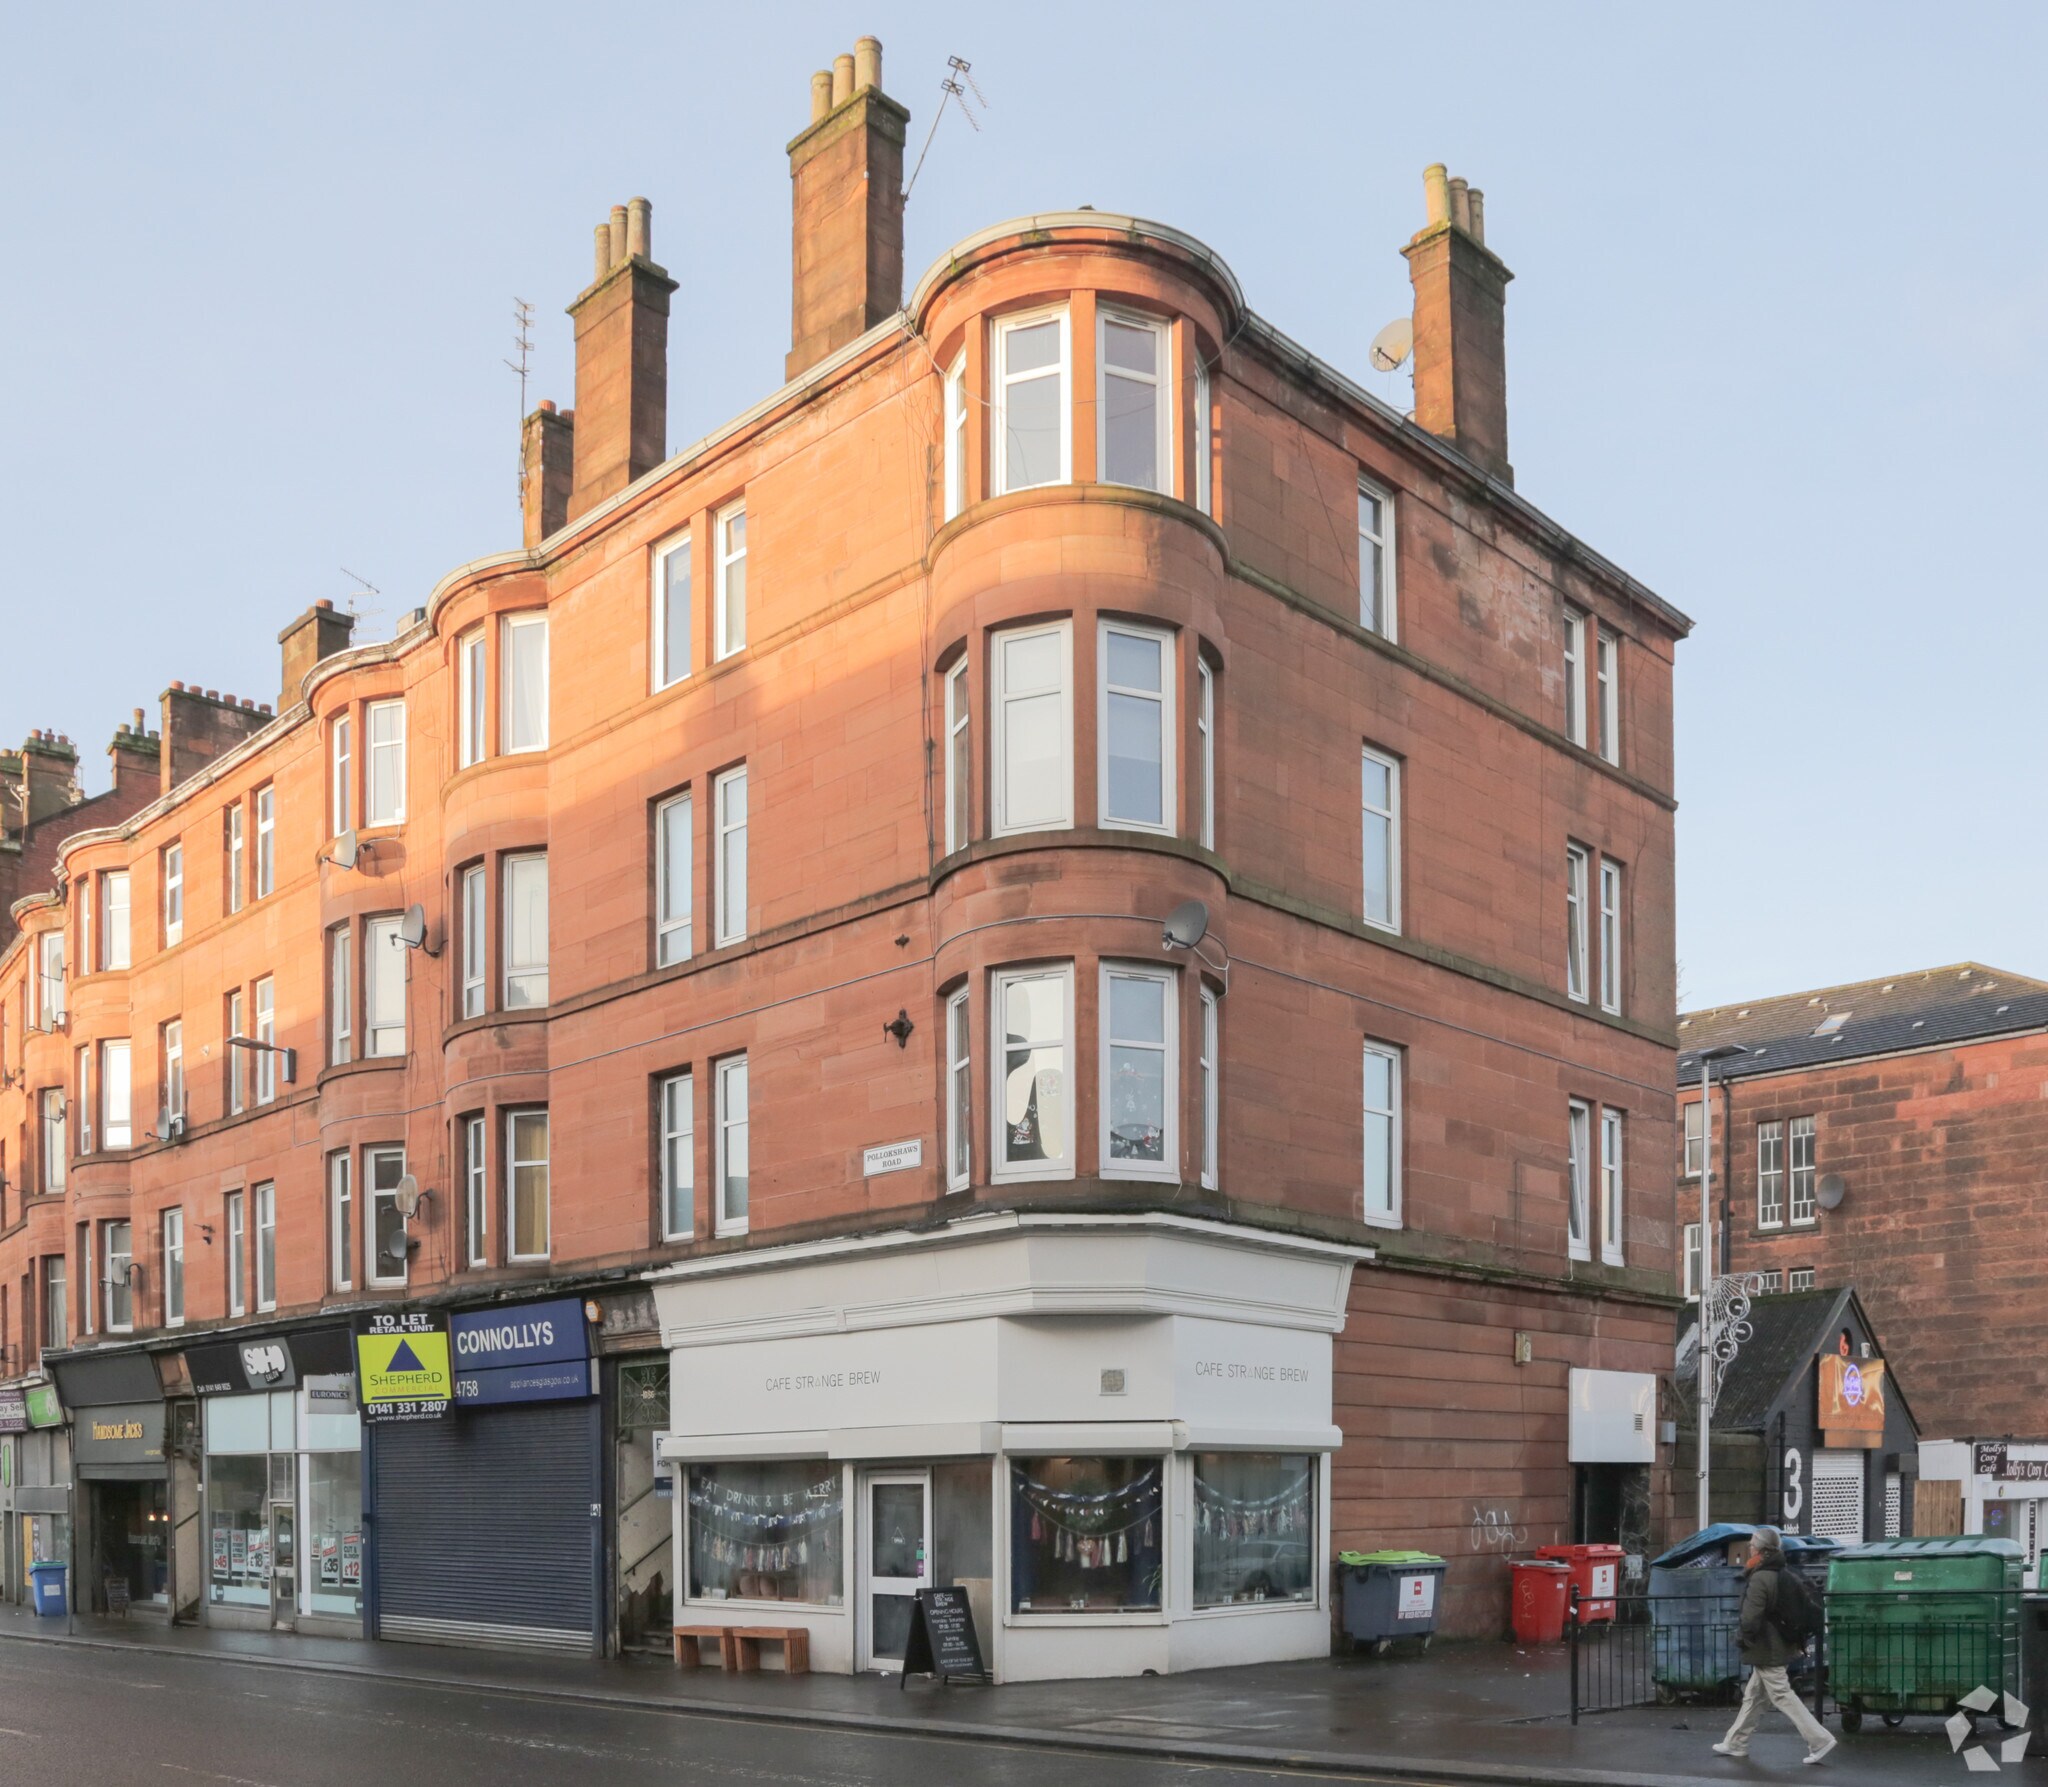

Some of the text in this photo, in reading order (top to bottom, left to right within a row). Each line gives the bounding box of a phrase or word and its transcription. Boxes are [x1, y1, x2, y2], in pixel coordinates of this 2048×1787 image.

[867, 1145, 918, 1161] POLLOKSHAWS
[882, 1158, 902, 1168] ROAD
[373, 1313, 428, 1327] TO LET
[369, 1324, 434, 1334] RETAIL UNIT
[457, 1321, 554, 1354] CONNOLLYS
[243, 1345, 286, 1375] SOHO
[265, 1370, 280, 1382] SALON
[369, 1372, 443, 1386] SHEPHERD
[1195, 1361, 1223, 1377] CAFE
[1280, 1367, 1309, 1382] BREW
[765, 1377, 791, 1391] CAFE
[849, 1370, 880, 1385] BREW
[375, 1385, 439, 1394] COMMERCIAL
[454, 1380, 479, 1397] 4758
[368, 1401, 447, 1414] 0141 331 2807
[376, 1412, 442, 1421] www.shepherd.co.uk
[1980, 1443, 2007, 1454] Molly's
[1980, 1454, 1997, 1463] Cosy
[2027, 1462, 2042, 1481] Cosy
[1784, 1448, 1802, 1519] 3
[701, 1477, 718, 1495] EAT
[726, 1489, 758, 1507] DRINK
[766, 1495, 772, 1507] &
[783, 1493, 793, 1506] BE
[324, 1558, 339, 1573] £35
[345, 1561, 360, 1577] £12
